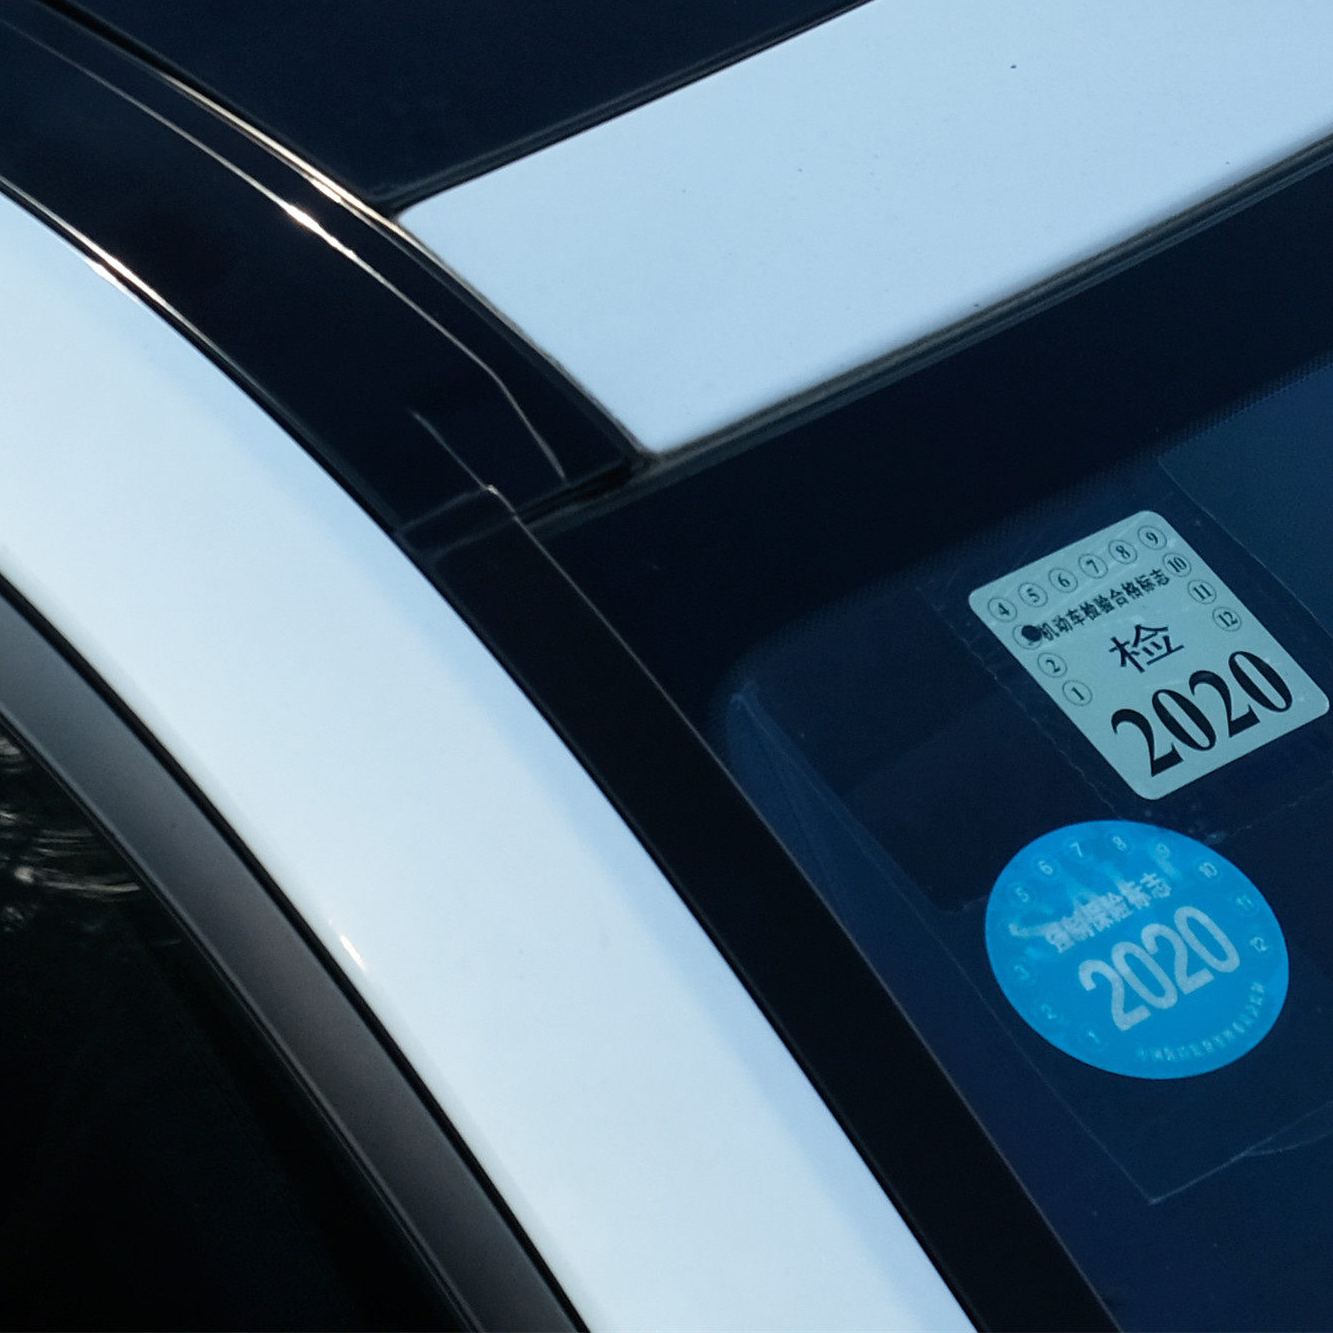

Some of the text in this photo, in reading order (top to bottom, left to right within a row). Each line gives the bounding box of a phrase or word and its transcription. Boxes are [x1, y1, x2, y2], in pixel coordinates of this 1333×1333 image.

[1109, 623, 1185, 674] 检
[1110, 650, 1293, 777] 2020
[1038, 859, 1054, 877] 6
[1068, 841, 1084, 858] 7
[1111, 835, 1128, 852] 8
[1197, 861, 1218, 879] 10
[1249, 936, 1269, 953] 12
[1078, 905, 1240, 1031] 2020
